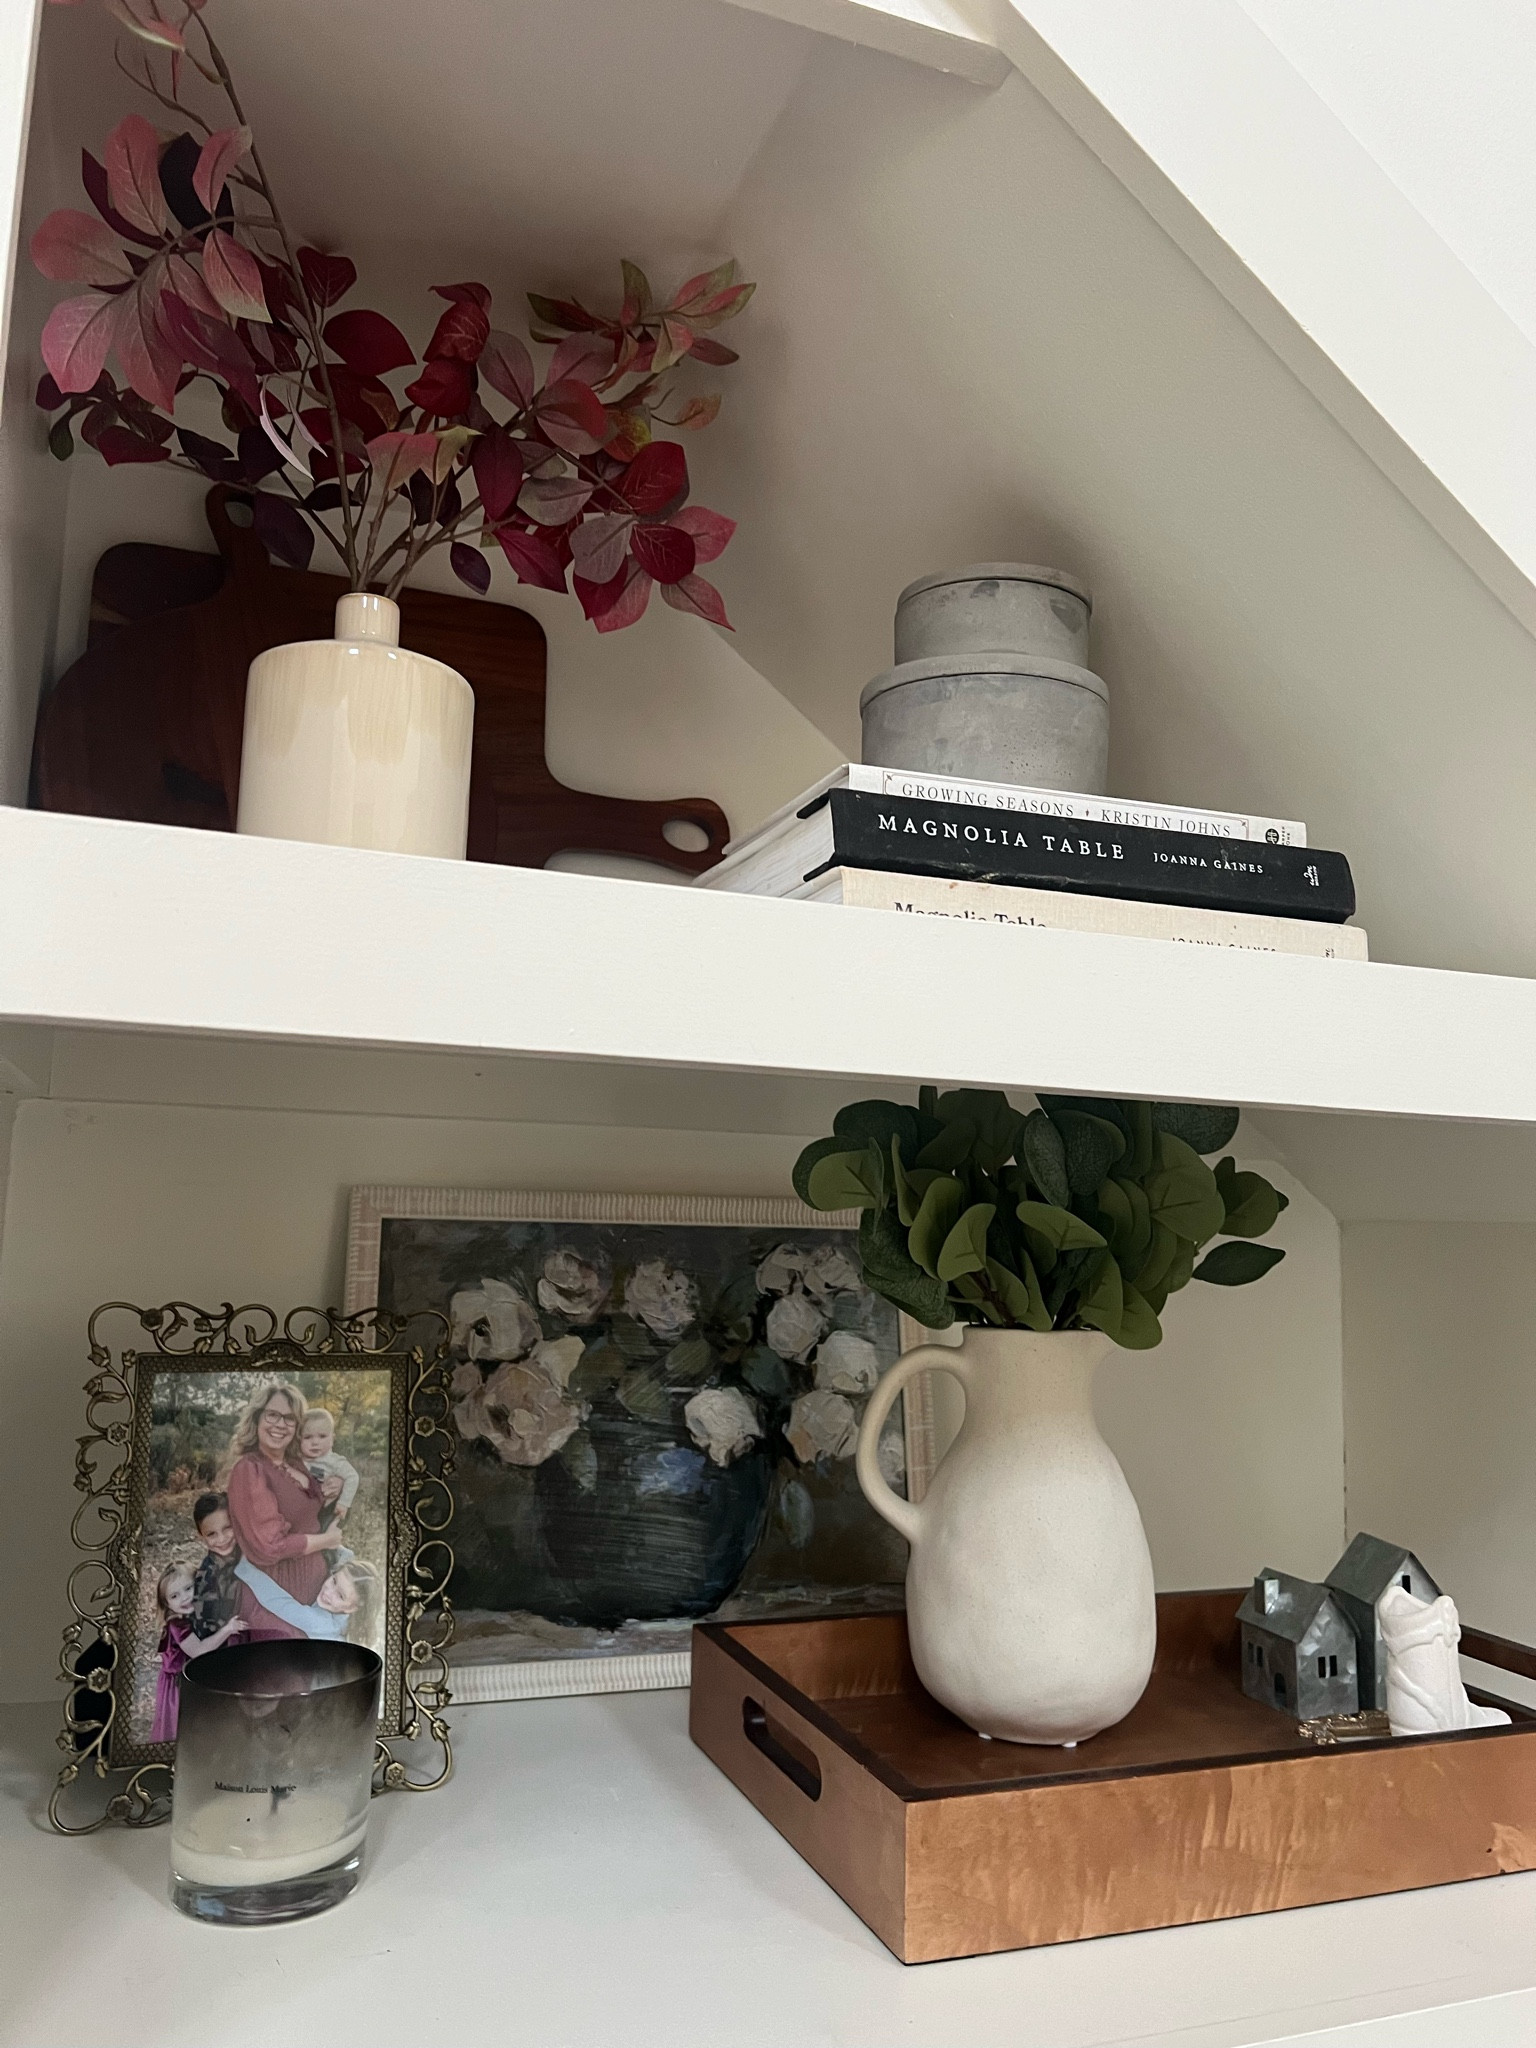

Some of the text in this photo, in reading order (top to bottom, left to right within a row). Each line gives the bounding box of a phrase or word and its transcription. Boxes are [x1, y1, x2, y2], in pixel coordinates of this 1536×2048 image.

[902, 783, 1231, 837] GROWING SEASONS KRISTIN JOHNS
[878, 814, 1264, 874] MAGNOLIA TABLE JOANNA GAINES
